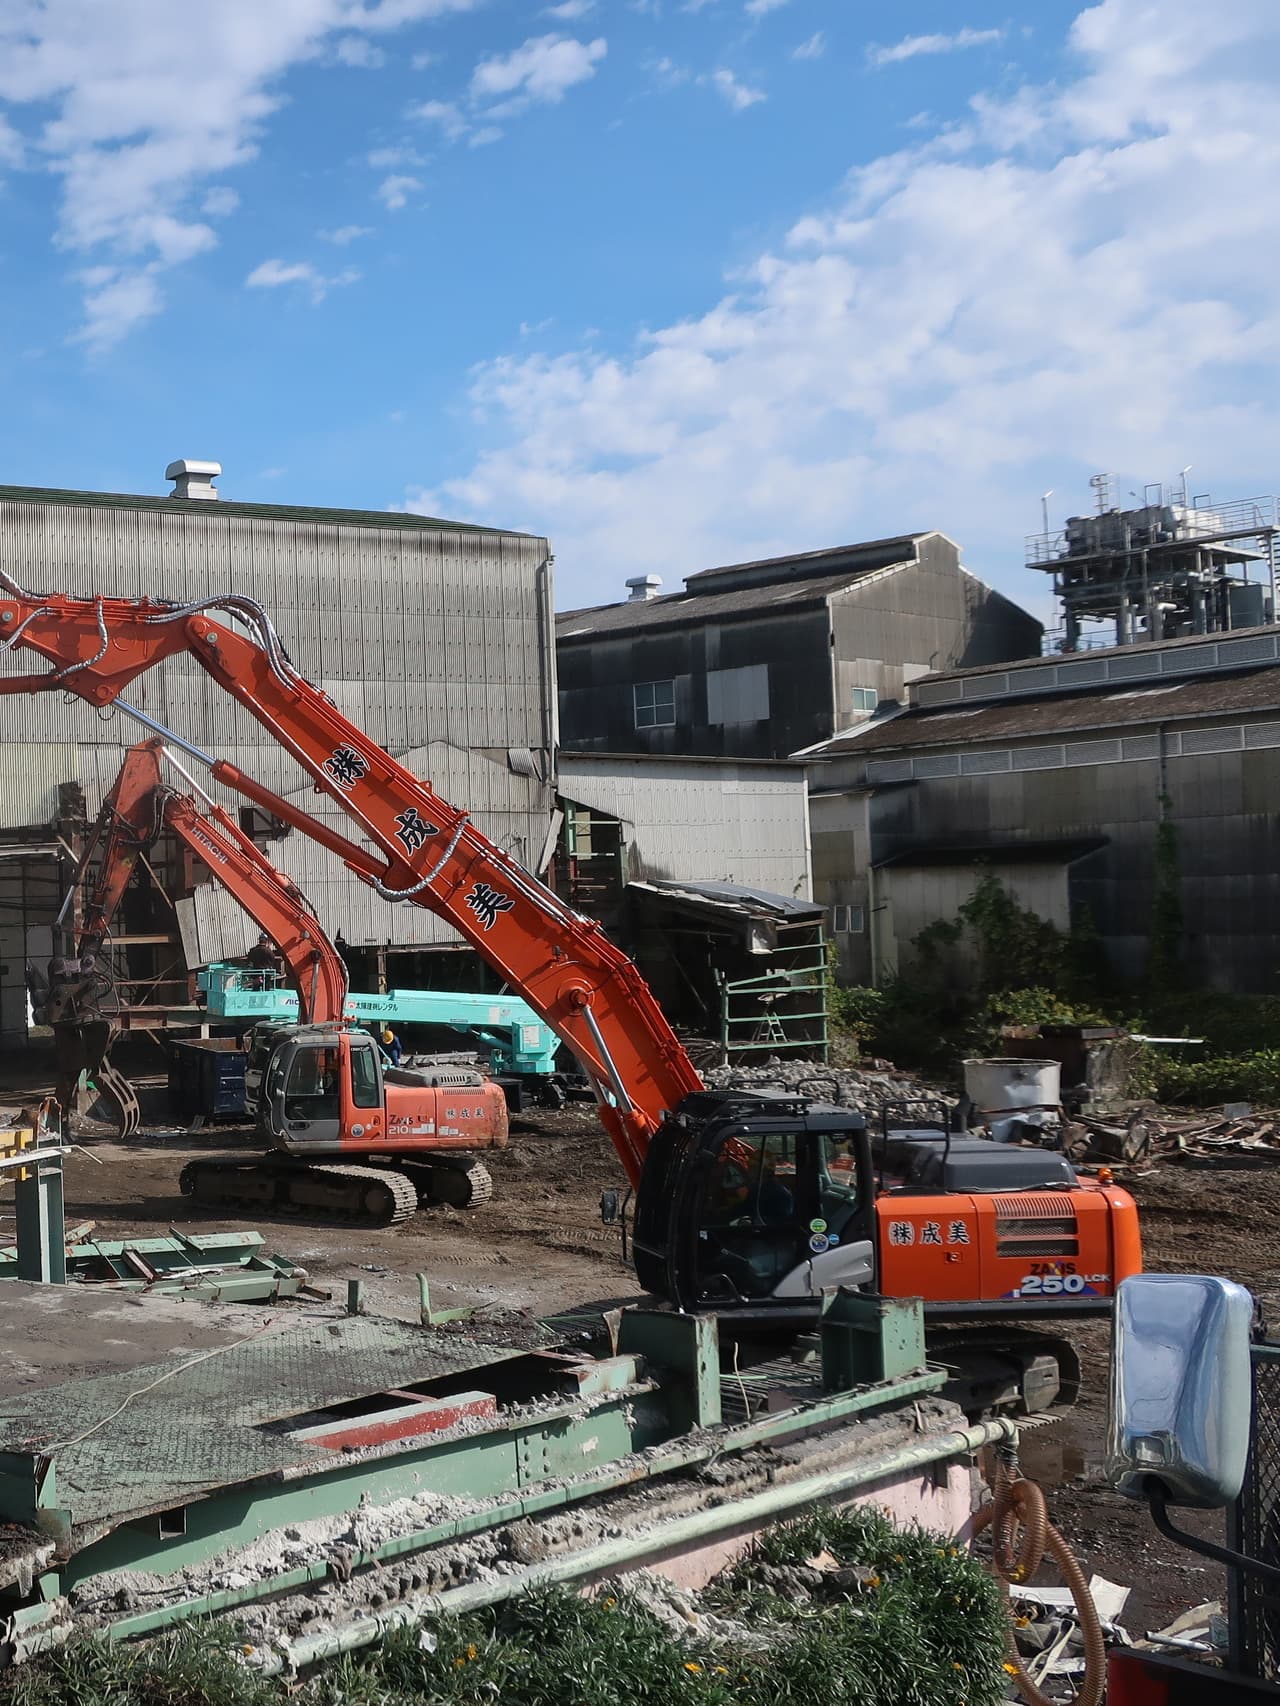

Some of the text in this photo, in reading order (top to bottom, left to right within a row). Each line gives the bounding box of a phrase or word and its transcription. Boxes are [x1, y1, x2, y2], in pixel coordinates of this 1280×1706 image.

[191, 826, 229, 865] HITACHI
[388, 1125, 409, 1135] 210
[1030, 1260, 1077, 1276] ZAXIS
